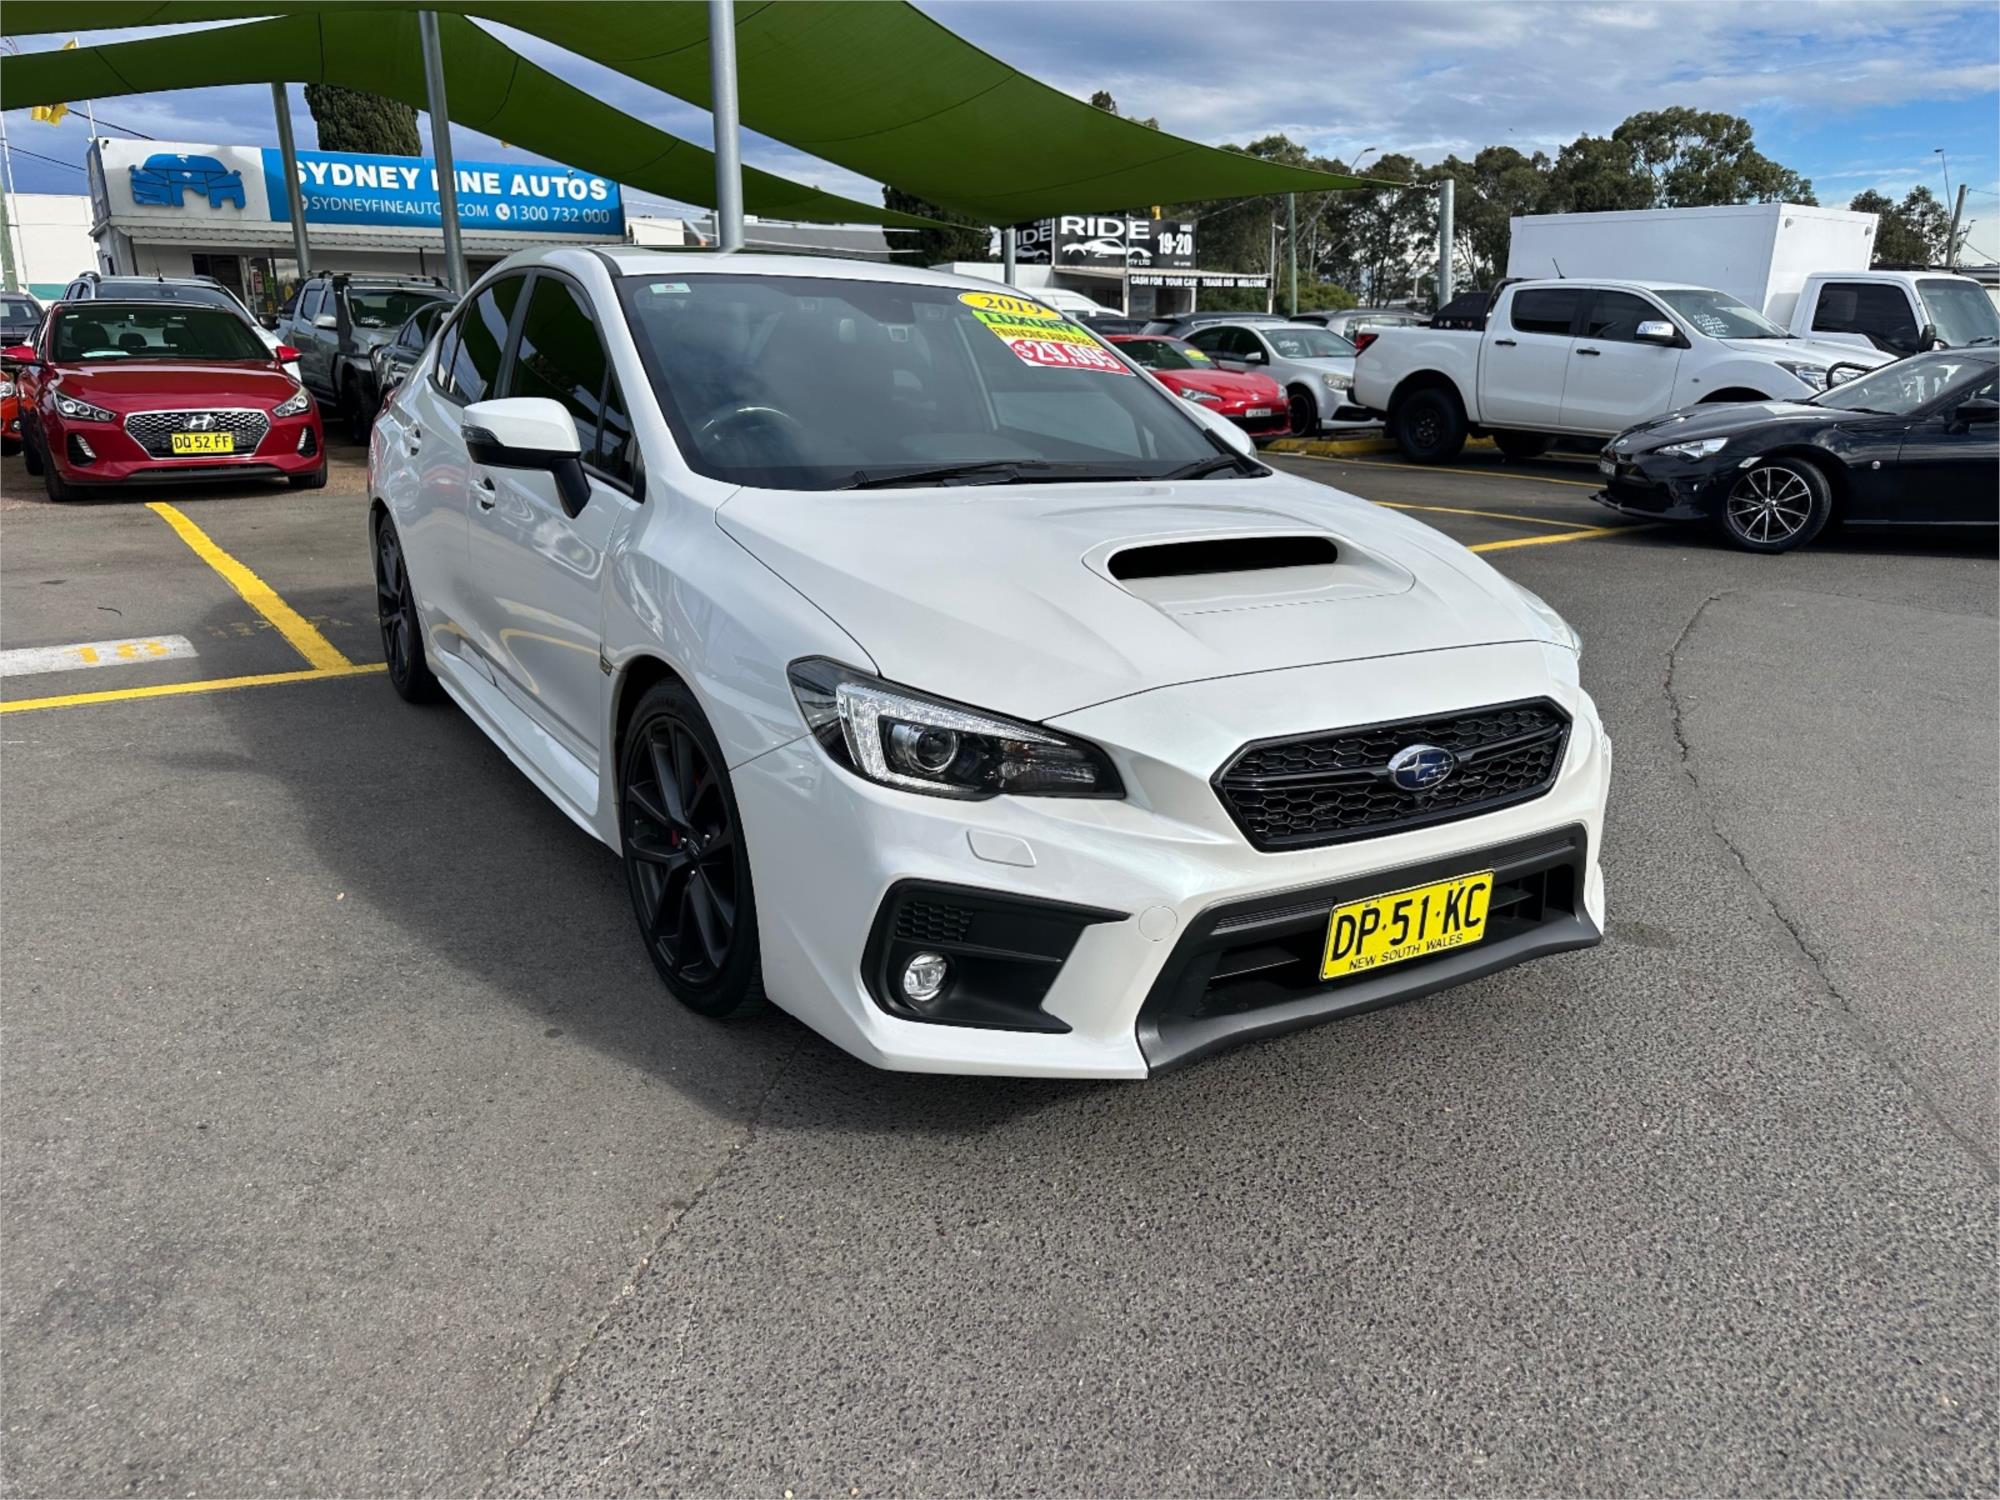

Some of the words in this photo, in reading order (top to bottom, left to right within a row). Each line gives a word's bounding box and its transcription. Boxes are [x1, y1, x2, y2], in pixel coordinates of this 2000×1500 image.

[296, 160, 419, 190] SYDNEY
[510, 174, 608, 201] AUTOS
[312, 196, 489, 218] SYDNEYFINEAUTOCOM
[512, 205, 549, 221] 1300
[551, 206, 580, 223] 732
[582, 208, 611, 224] 000
[1016, 226, 1052, 246] IDE
[1060, 215, 1150, 240] RIDE
[1157, 232, 1193, 255] 19-20
[1130, 275, 1149, 286] CASH
[1150, 276, 1163, 286] FOR
[1165, 277, 1183, 287] YOUR
[1184, 277, 1198, 287] CAR
[1237, 278, 1267, 289] WELCOME
[979, 296, 1043, 315] 2019
[984, 313, 1075, 333] LUXURY
[1014, 339, 1122, 371] $29,995
[1349, 954, 1377, 971] NEW
[1380, 944, 1421, 962] SOUTH
[1426, 933, 1464, 952] WALES
